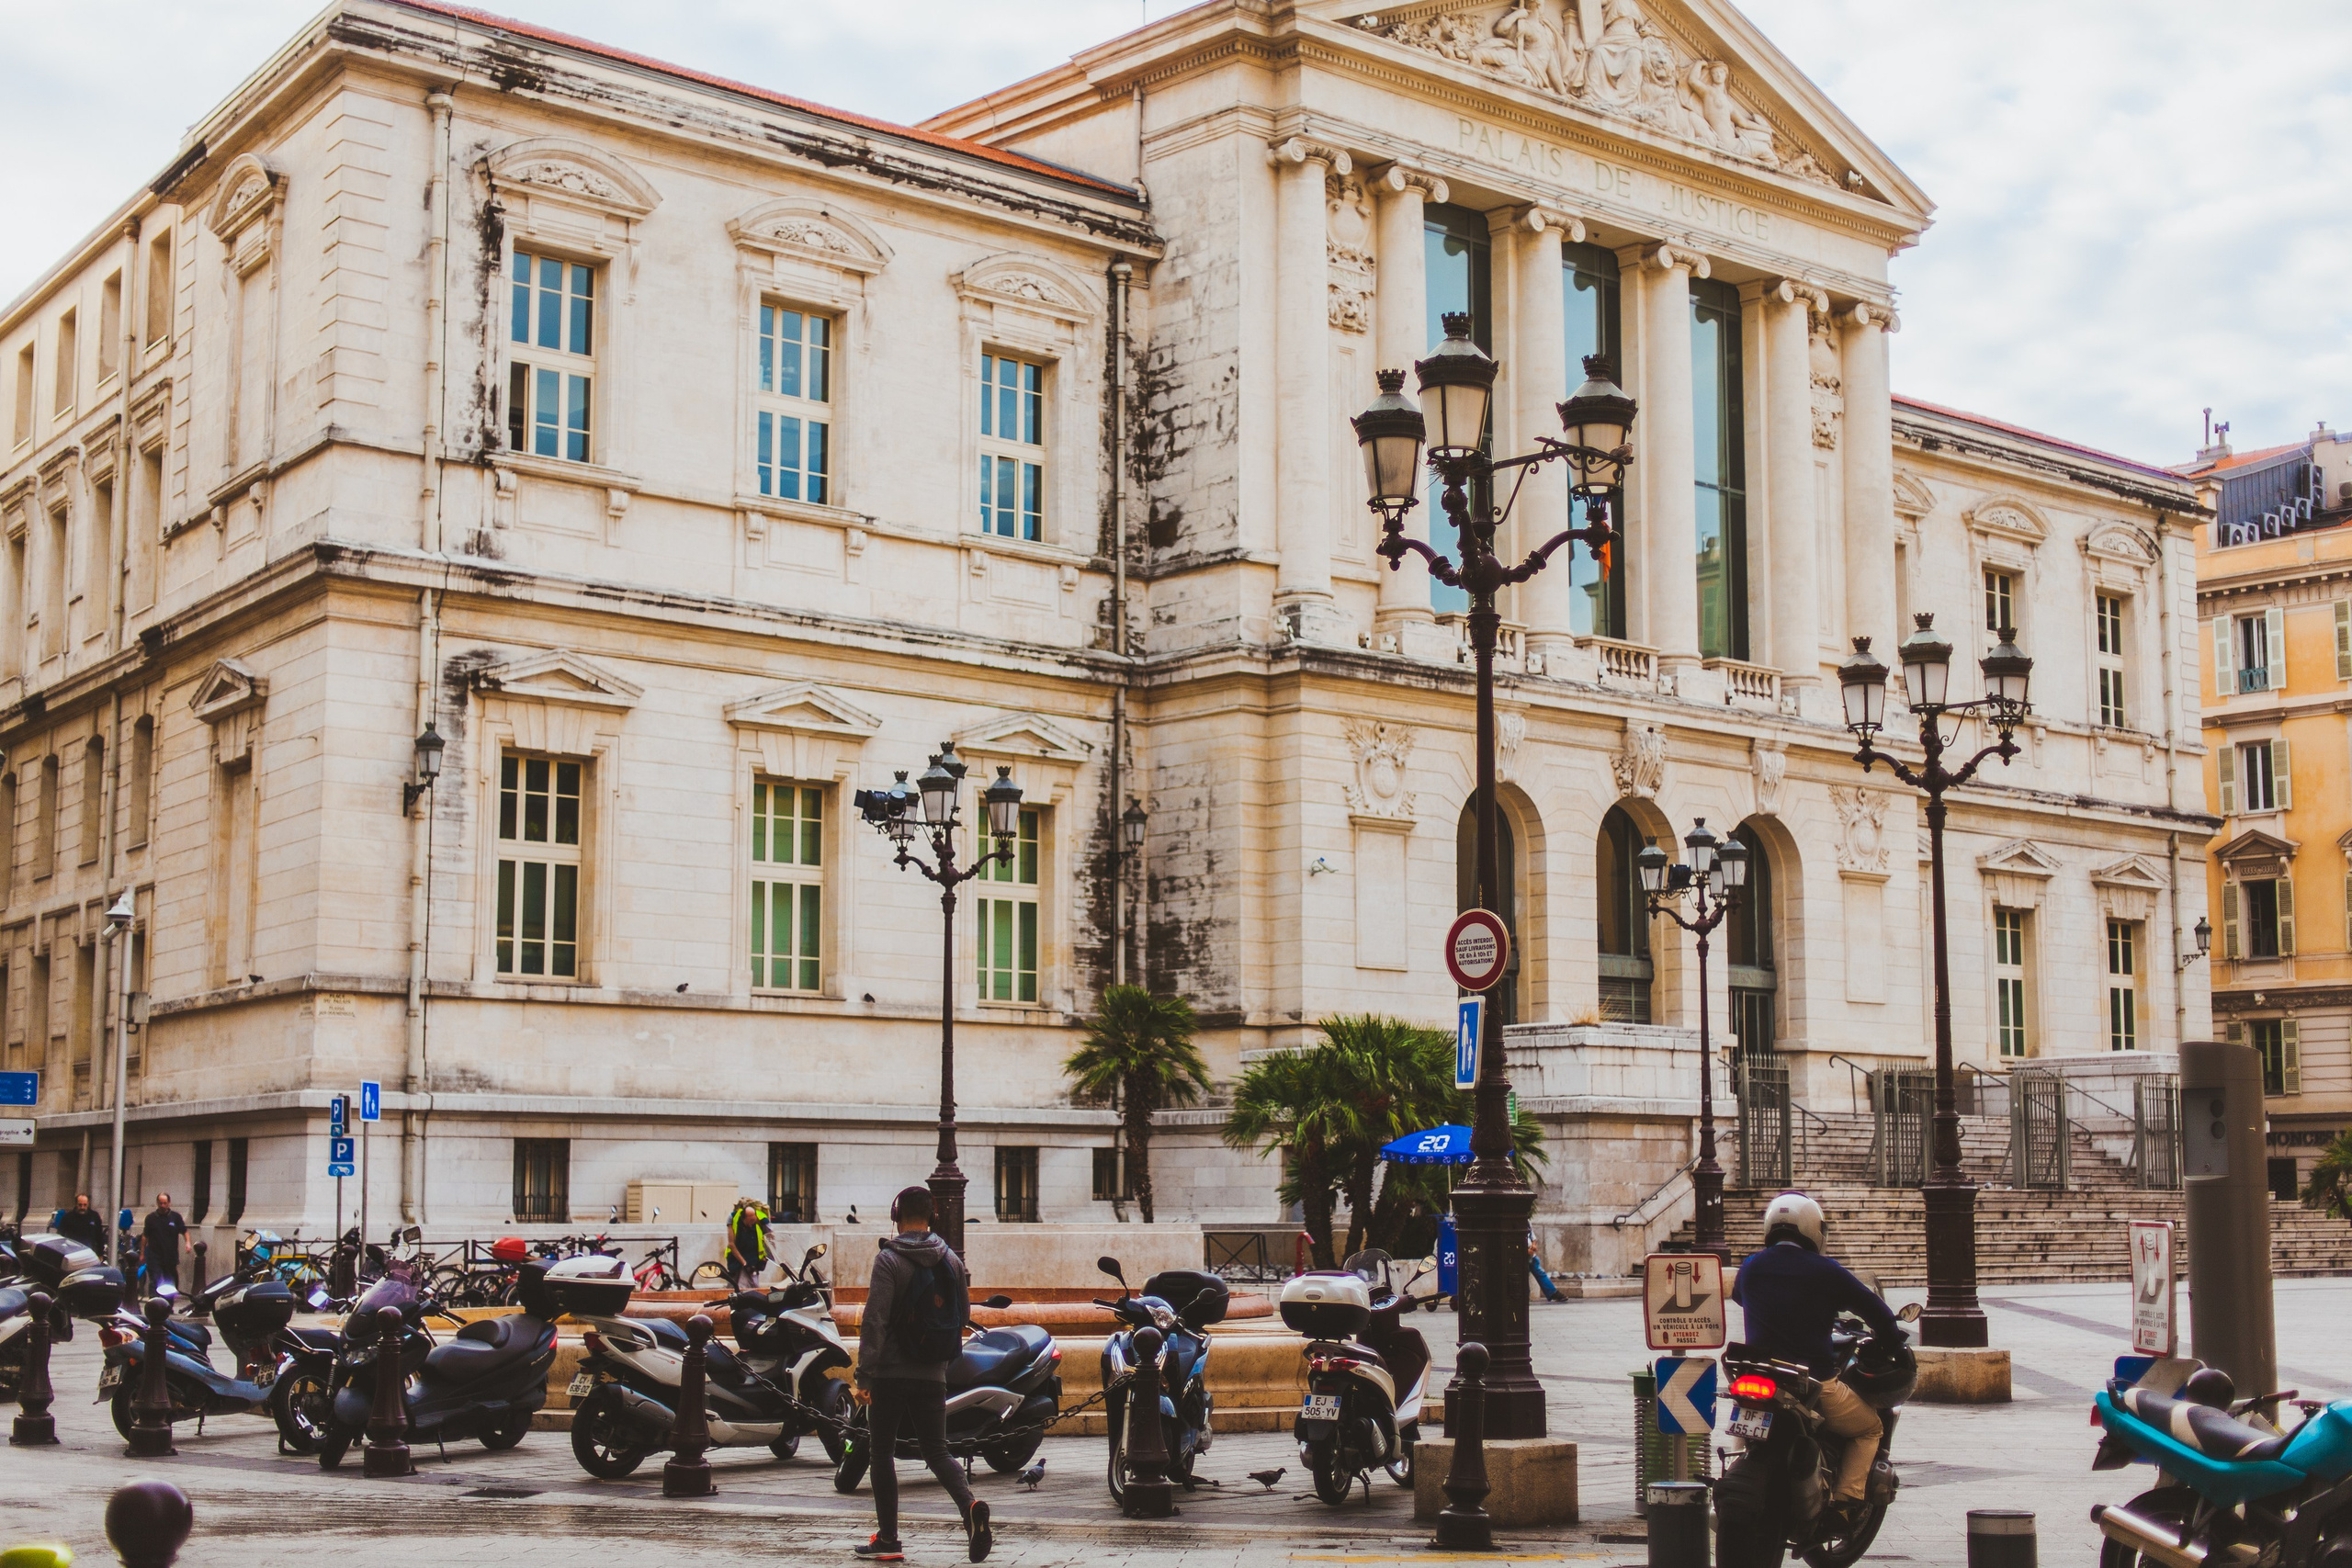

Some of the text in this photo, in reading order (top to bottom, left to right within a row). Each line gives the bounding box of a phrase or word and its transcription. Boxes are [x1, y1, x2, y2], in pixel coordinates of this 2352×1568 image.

[1458, 118, 1769, 242] PALAIS DE JUSTICE
[1468, 943, 1496, 952] LIVRAISONS
[1418, 1134, 1451, 1150] 20
[336, 1142, 347, 1158] P
[1443, 1252, 1455, 1265] 20
[1305, 1407, 1337, 1416] 505-YV
[1729, 1423, 1767, 1438] 455-CT
